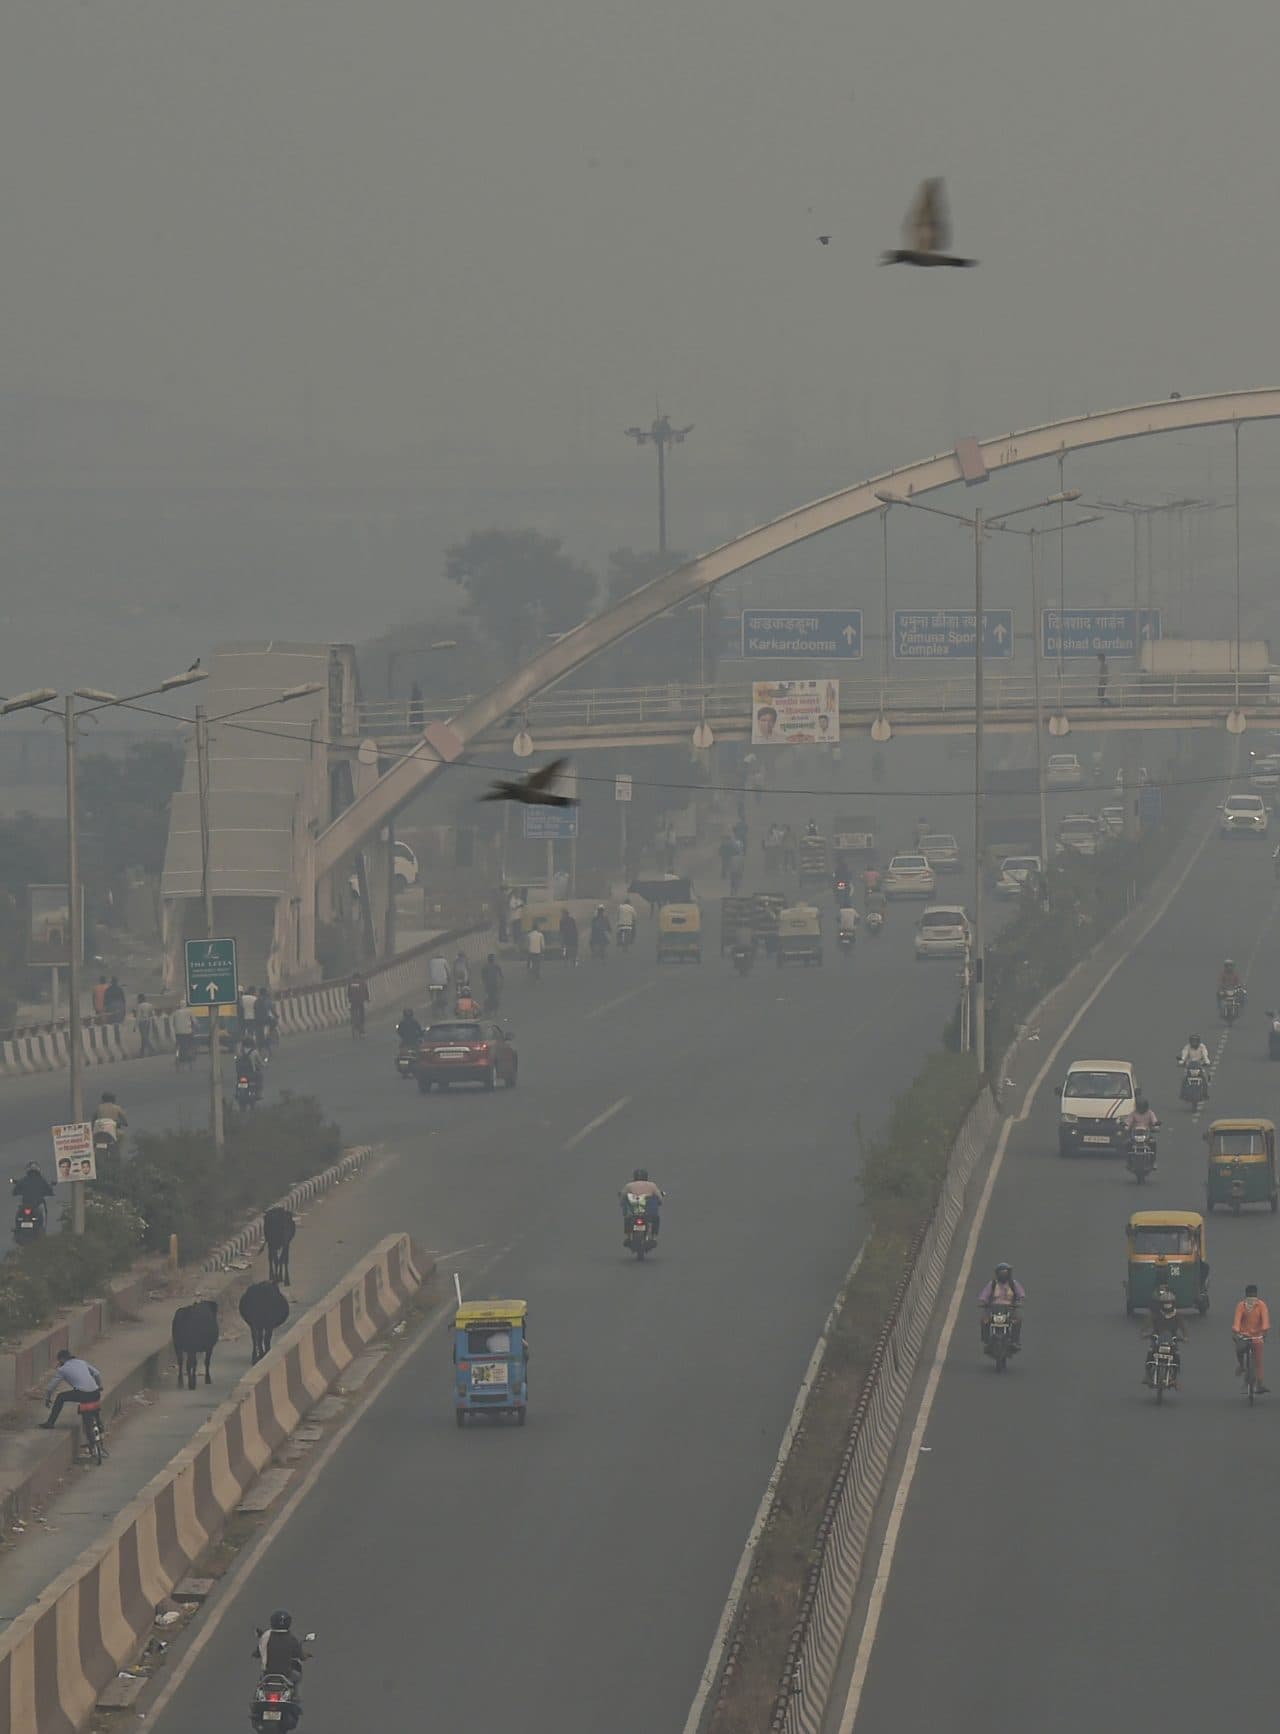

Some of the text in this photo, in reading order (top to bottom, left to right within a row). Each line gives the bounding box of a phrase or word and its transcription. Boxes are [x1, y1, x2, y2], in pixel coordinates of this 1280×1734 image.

[748, 637, 838, 651] Karkardooma
[900, 630, 985, 645] Yamuna Spor
[1093, 637, 1133, 650] Garden
[899, 643, 950, 656] Complex
